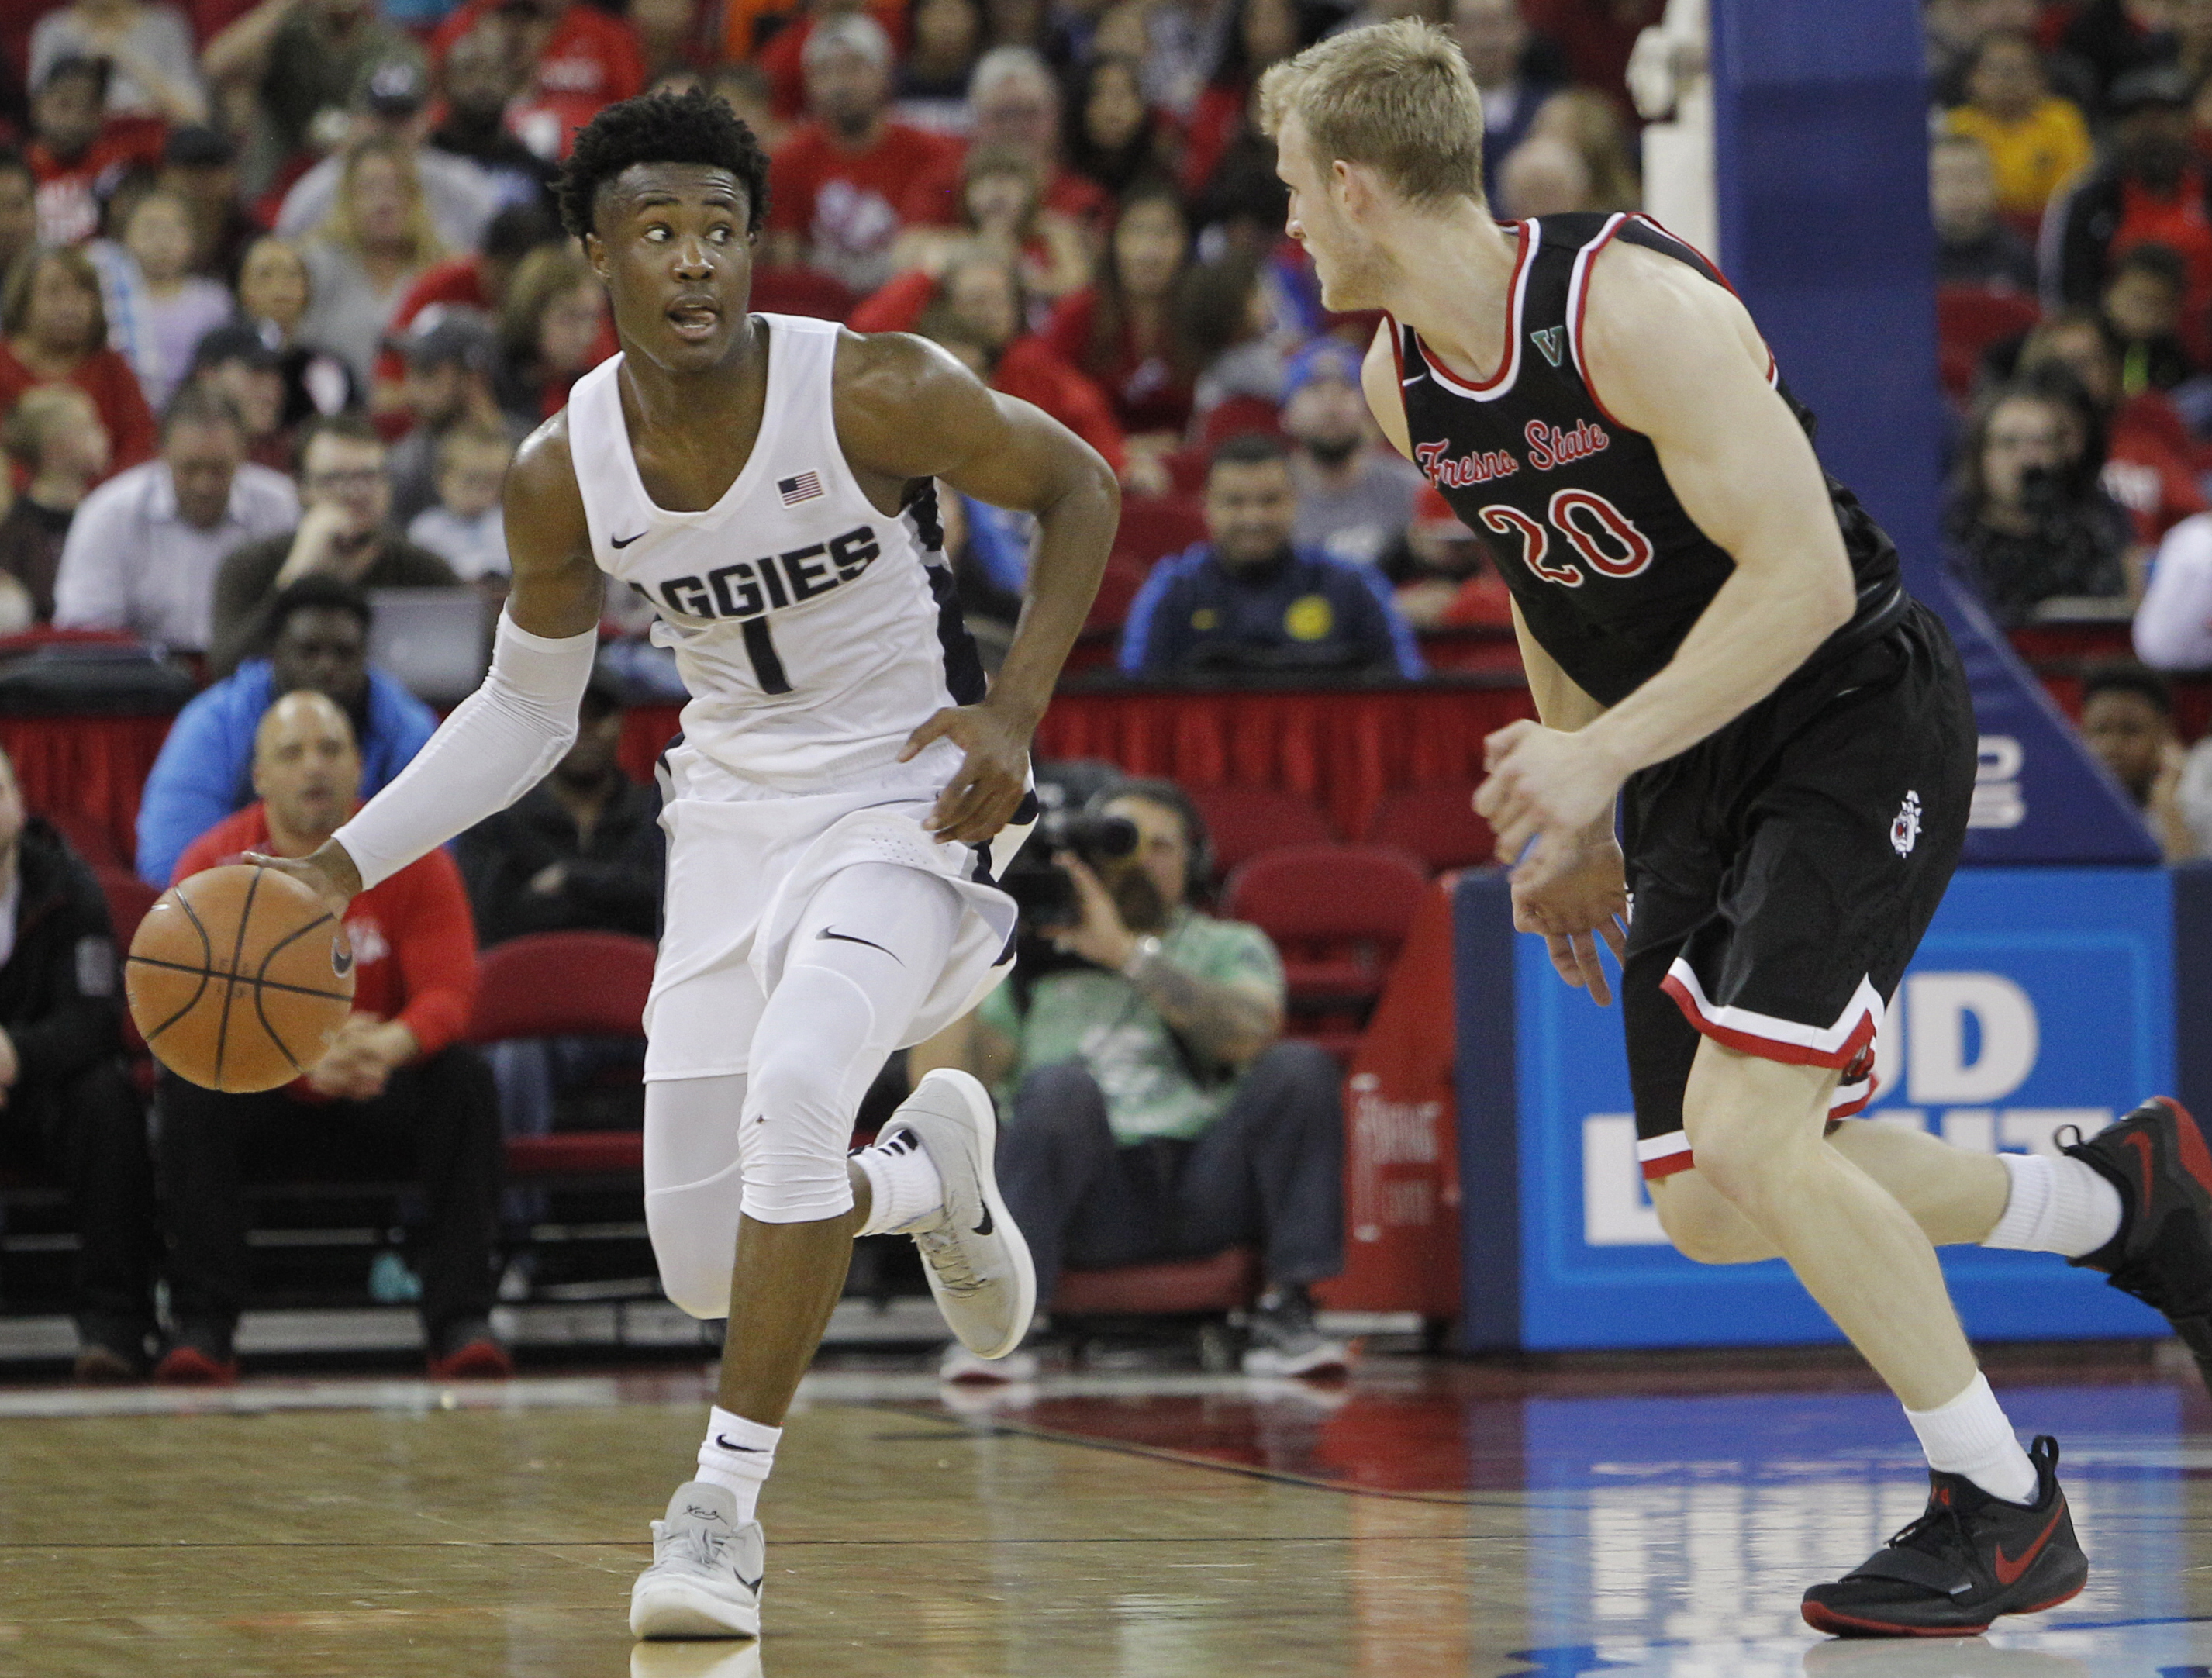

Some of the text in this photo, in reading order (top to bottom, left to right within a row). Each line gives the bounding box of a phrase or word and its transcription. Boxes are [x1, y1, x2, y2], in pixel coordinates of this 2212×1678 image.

[1415, 419, 1609, 489] Fresno State
[628, 526, 881, 619] GGIES
[1478, 488, 1654, 588] 20
[739, 615, 794, 695] 1
